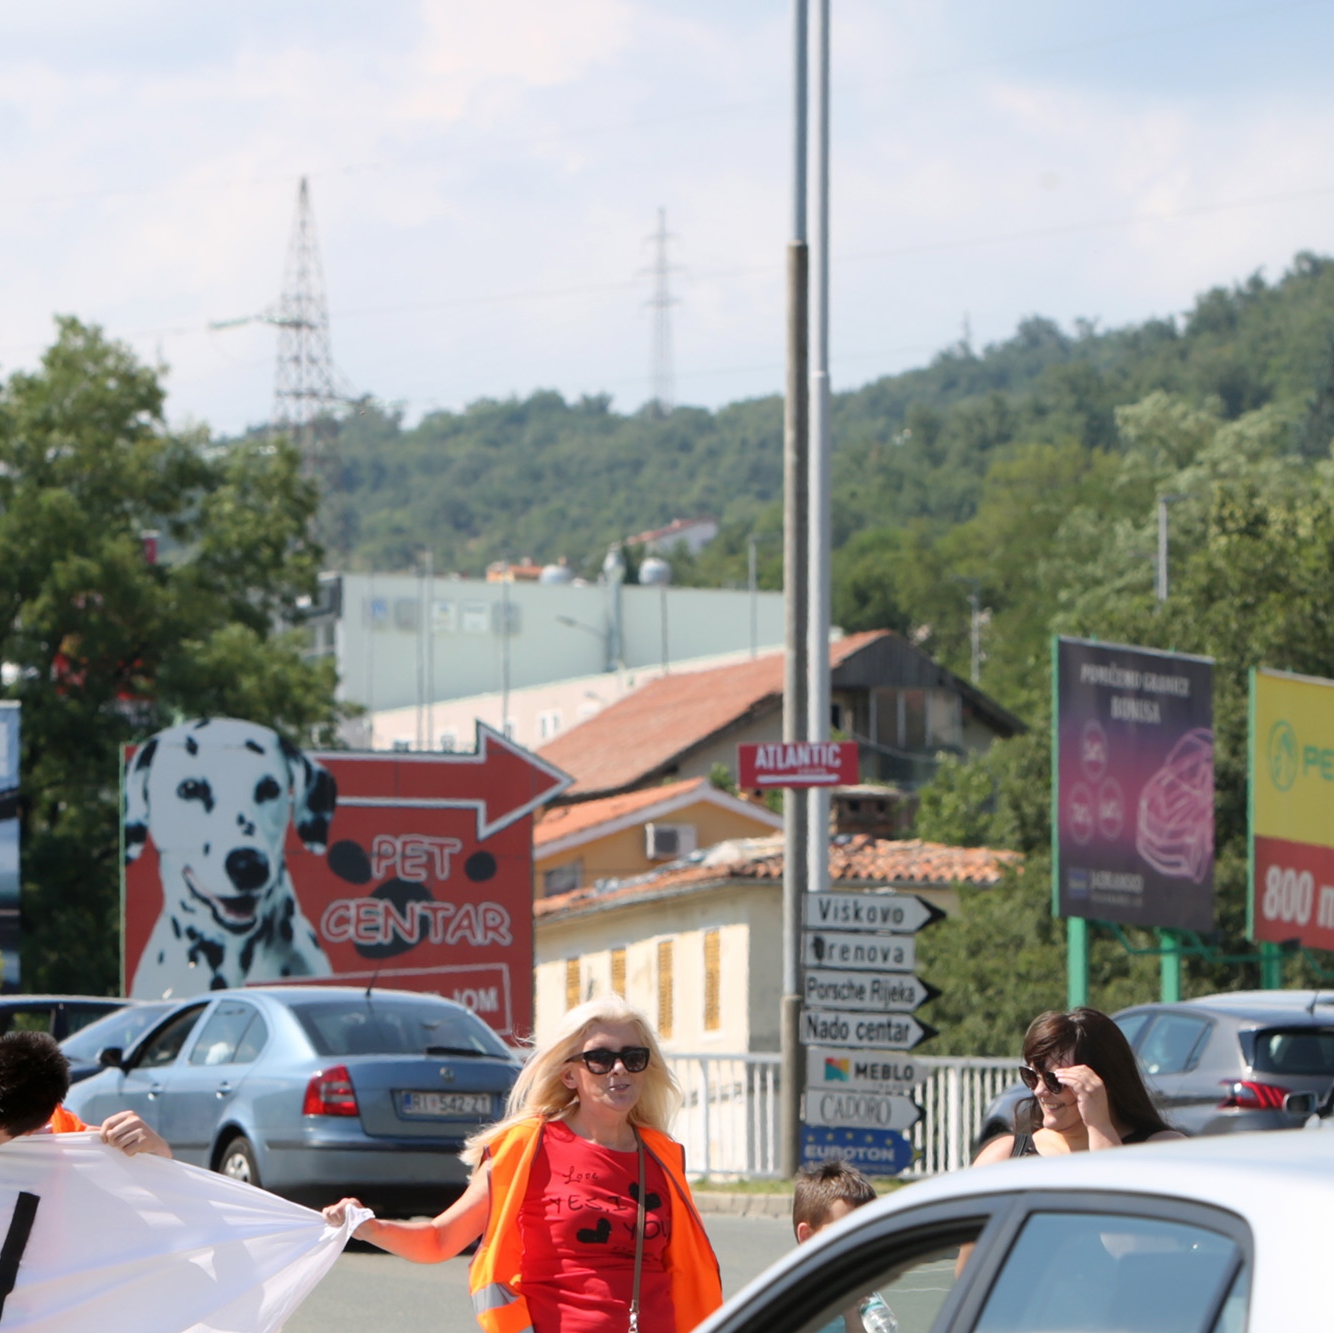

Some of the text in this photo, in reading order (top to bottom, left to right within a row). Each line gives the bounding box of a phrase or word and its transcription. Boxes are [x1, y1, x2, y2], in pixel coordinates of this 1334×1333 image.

[754, 743, 843, 769] ATLANTIC
[371, 834, 462, 882] PET
[1262, 865, 1314, 926] 800
[321, 898, 513, 946] CENTAR
[818, 898, 905, 925] Viškovo
[811, 935, 905, 964] renova
[806, 976, 916, 1009] Porsche Rijeka
[806, 1014, 911, 1042] Nado centar
[854, 1062, 915, 1081] MEBLO
[820, 1093, 892, 1126] CADORO
[804, 1144, 896, 1162] EUROTON
[562, 1165, 599, 1185] Love
